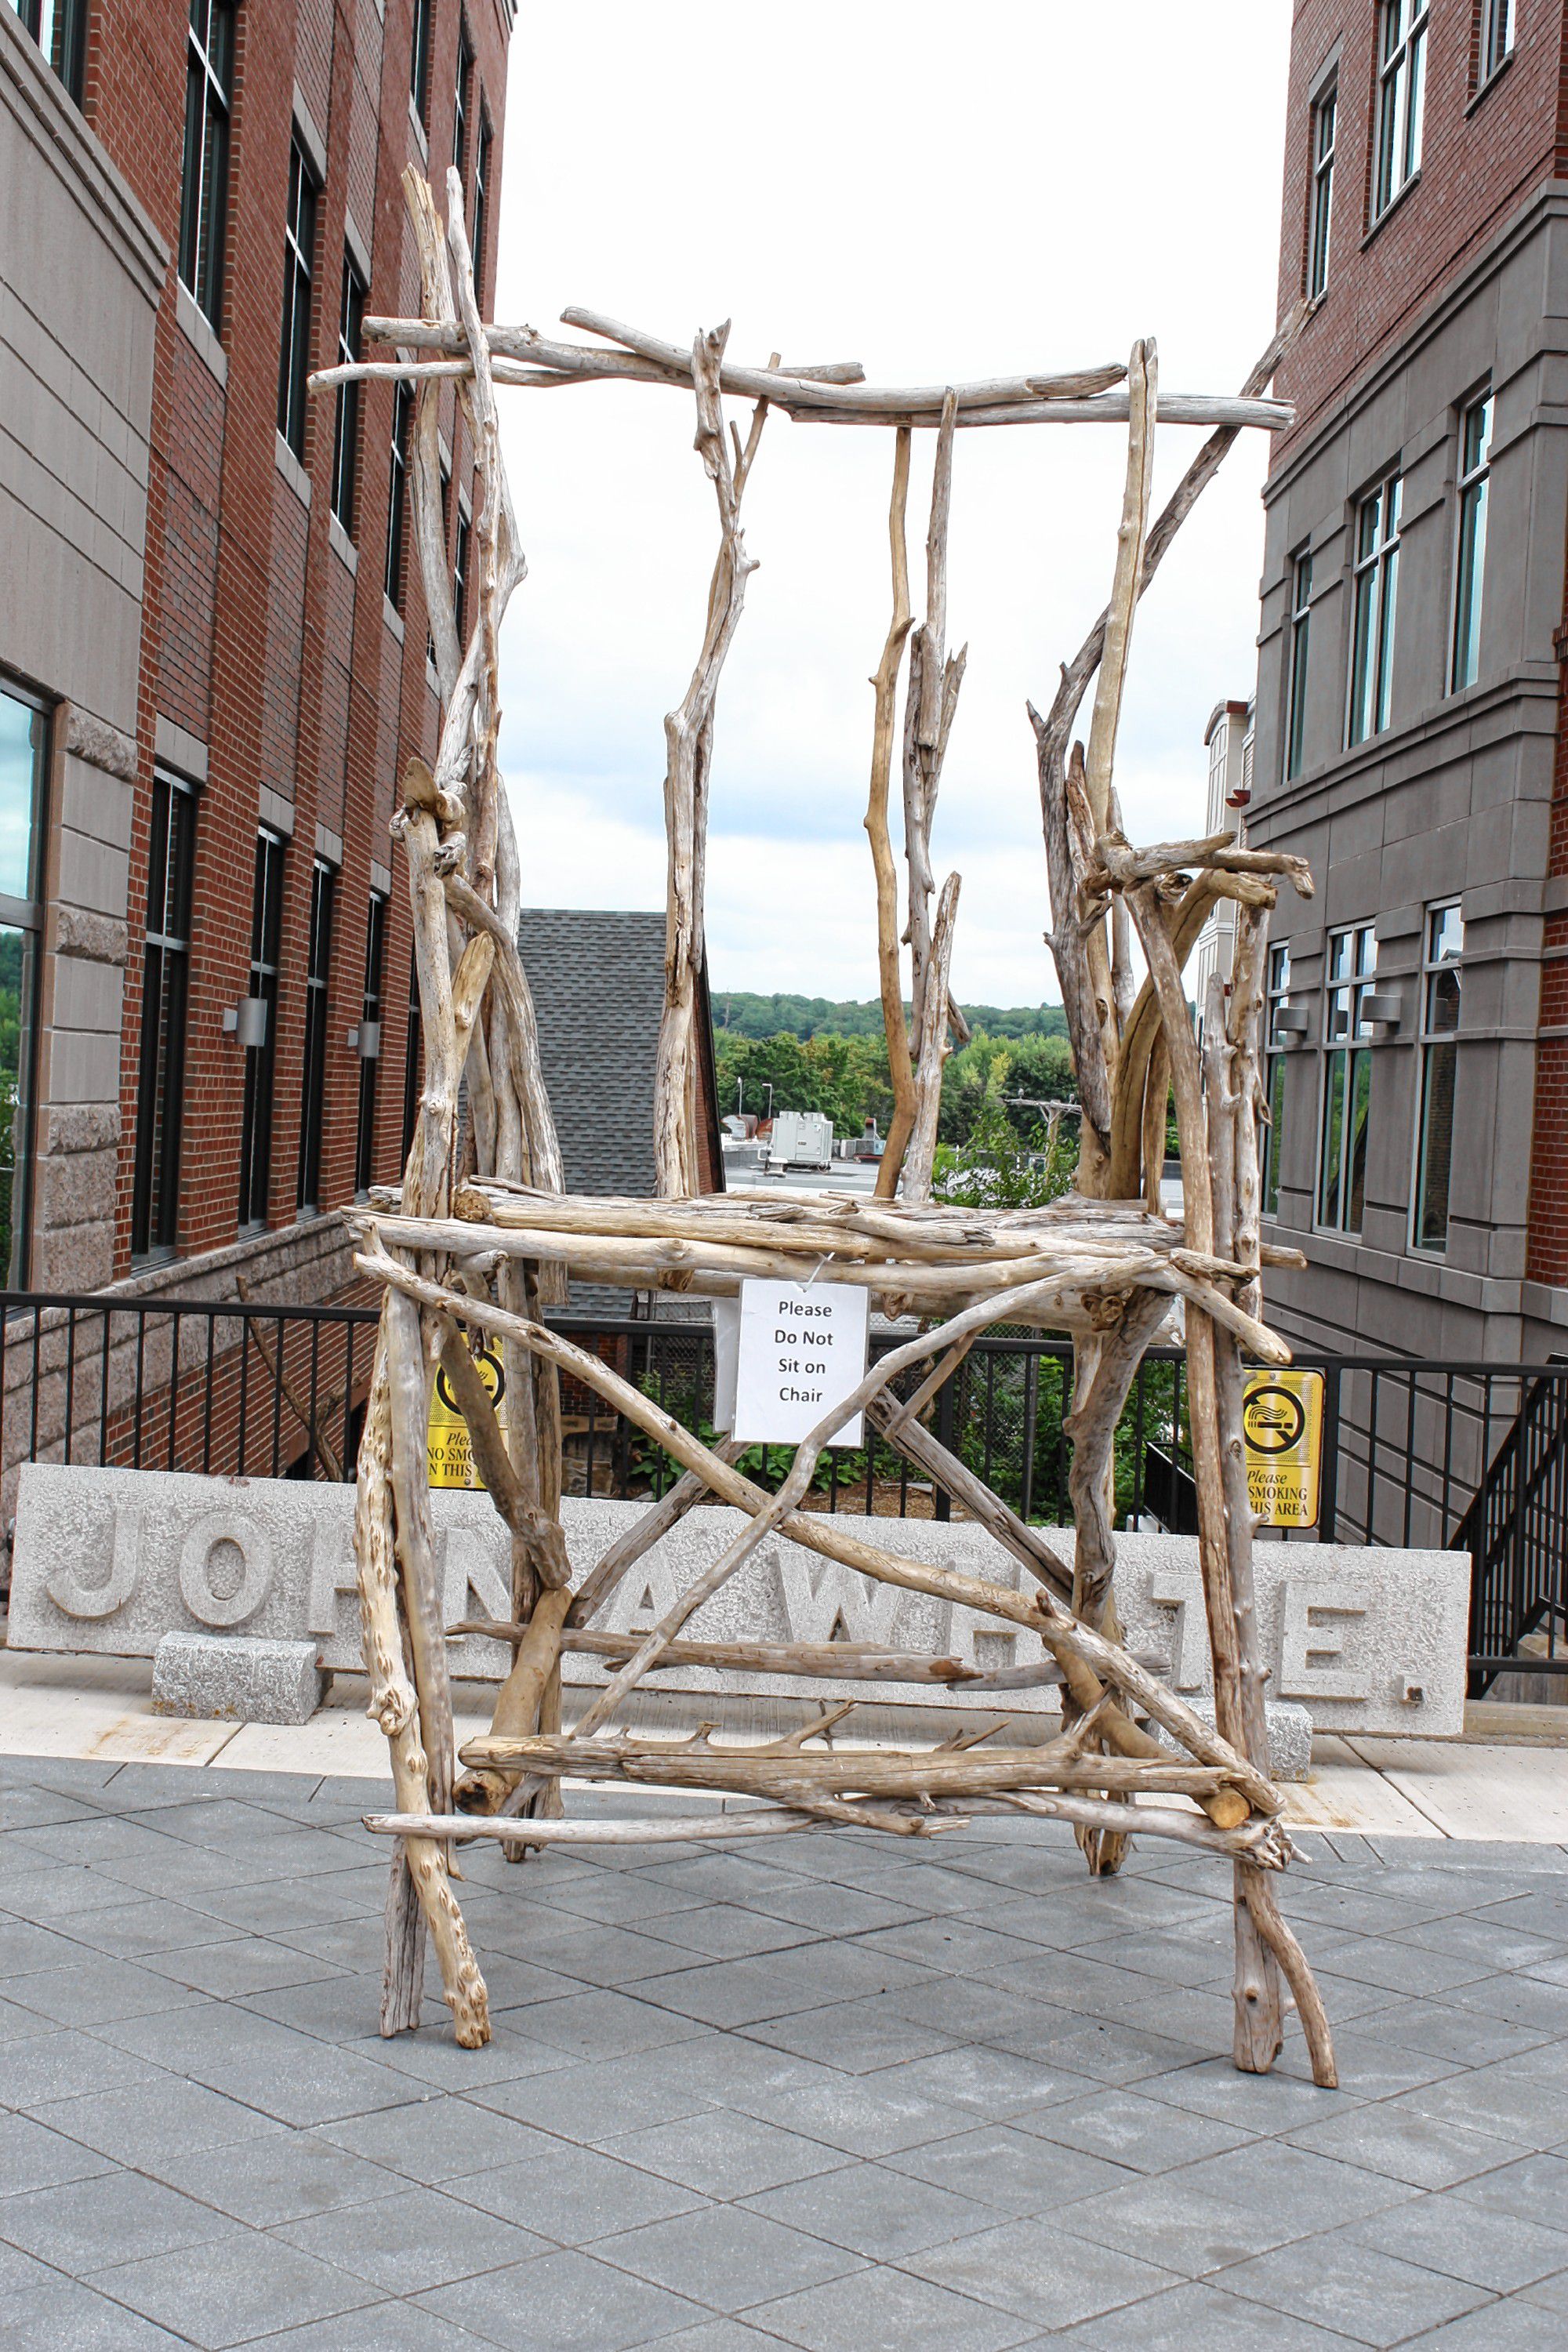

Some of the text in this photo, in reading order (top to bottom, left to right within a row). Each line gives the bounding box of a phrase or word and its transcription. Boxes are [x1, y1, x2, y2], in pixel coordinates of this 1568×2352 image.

[779, 1301, 833, 1317] Please
[775, 1330, 833, 1346] Do Not
[778, 1358, 826, 1374] Sit on
[779, 1387, 823, 1402] Chair
[446, 1432, 474, 1446] Plea
[427, 1446, 444, 1461] NO
[442, 1463, 472, 1477] THIS
[1247, 1469, 1287, 1484] Please
[1248, 1485, 1307, 1501] SMOKING
[1250, 1501, 1308, 1516] HIS AREA
